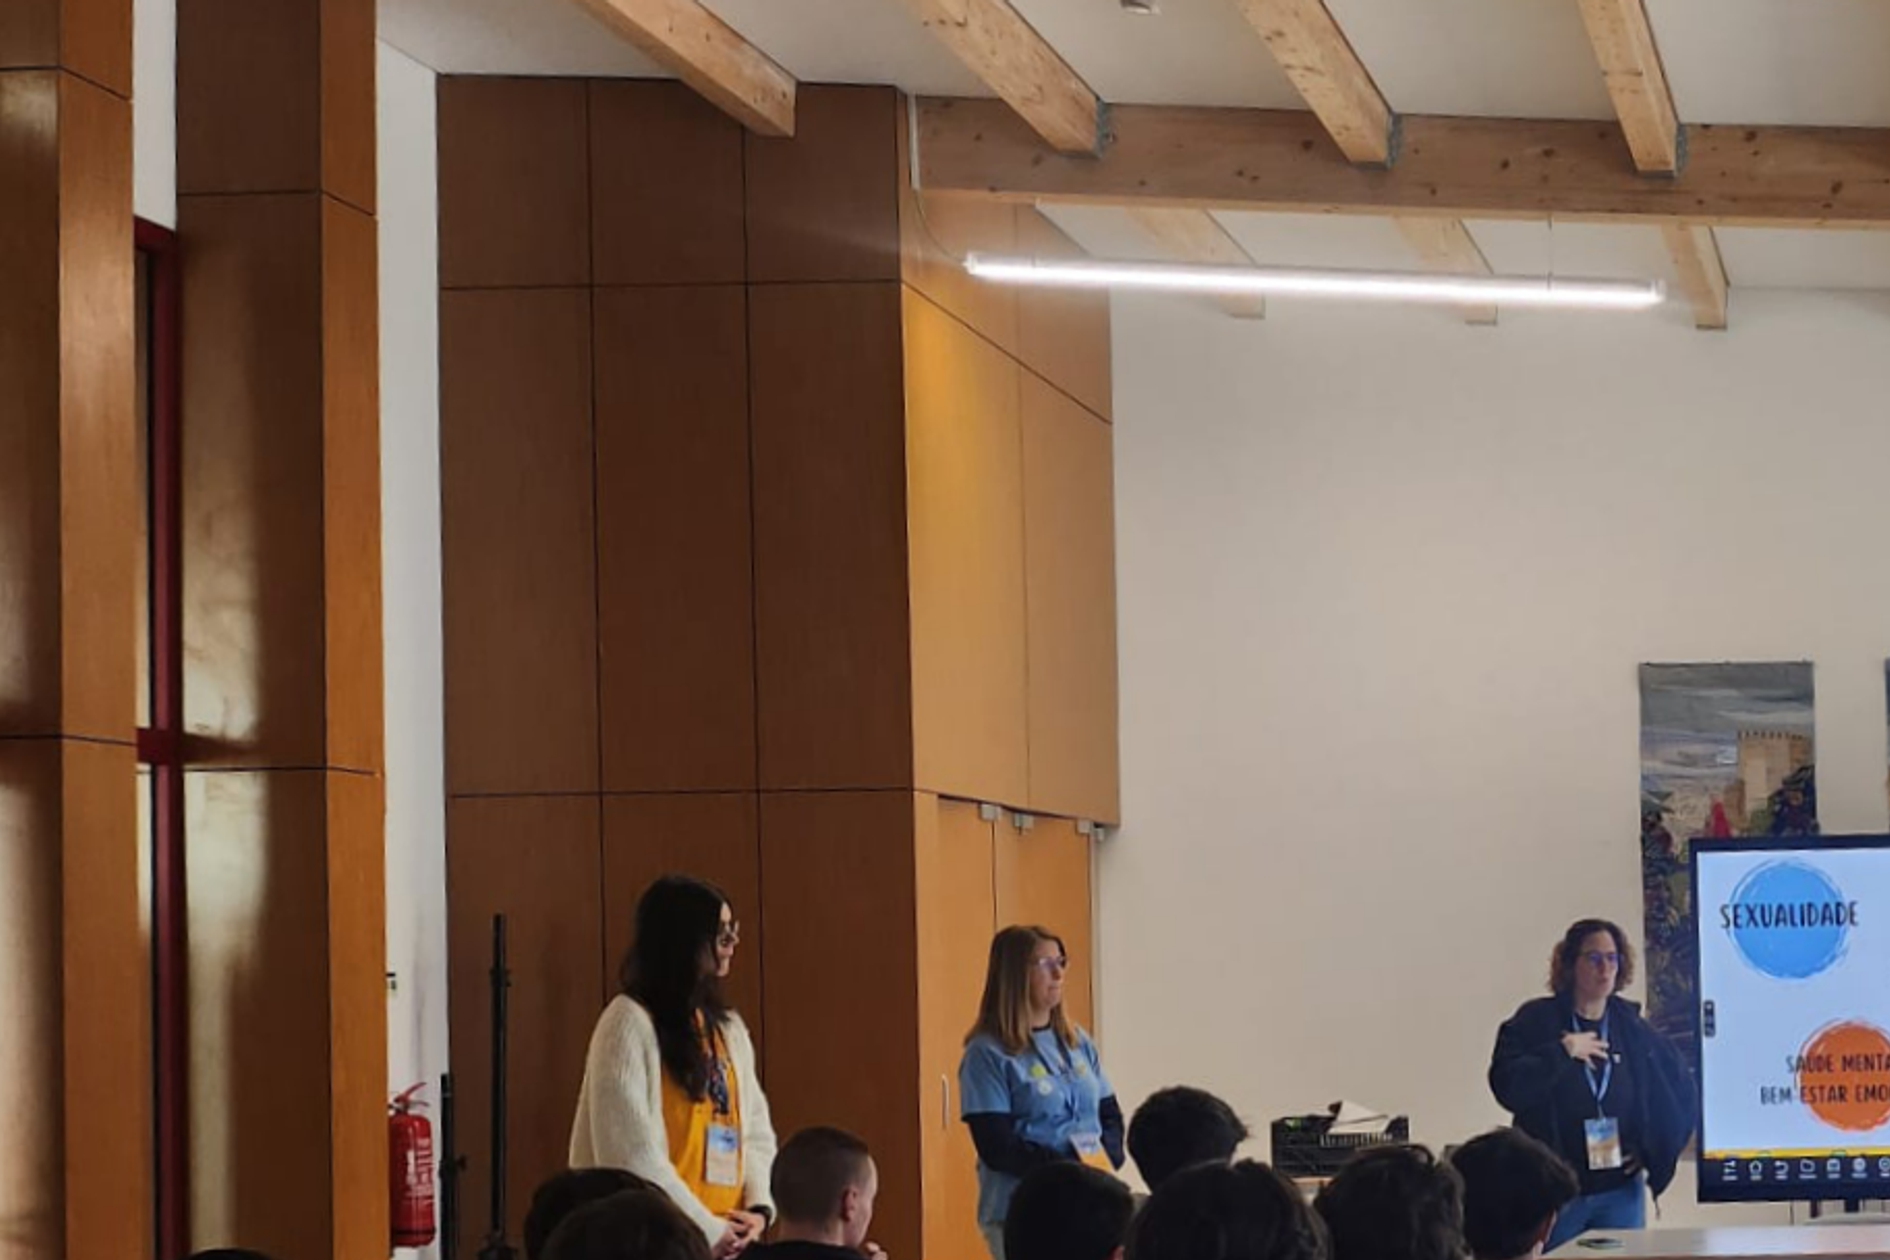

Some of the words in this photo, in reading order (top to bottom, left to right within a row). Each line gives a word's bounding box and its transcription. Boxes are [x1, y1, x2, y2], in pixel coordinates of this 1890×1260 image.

[1719, 900, 1859, 929] SEXUALIDADE
[1760, 1086, 1792, 1105] BEM
[1800, 1084, 1848, 1104] ESTAR
